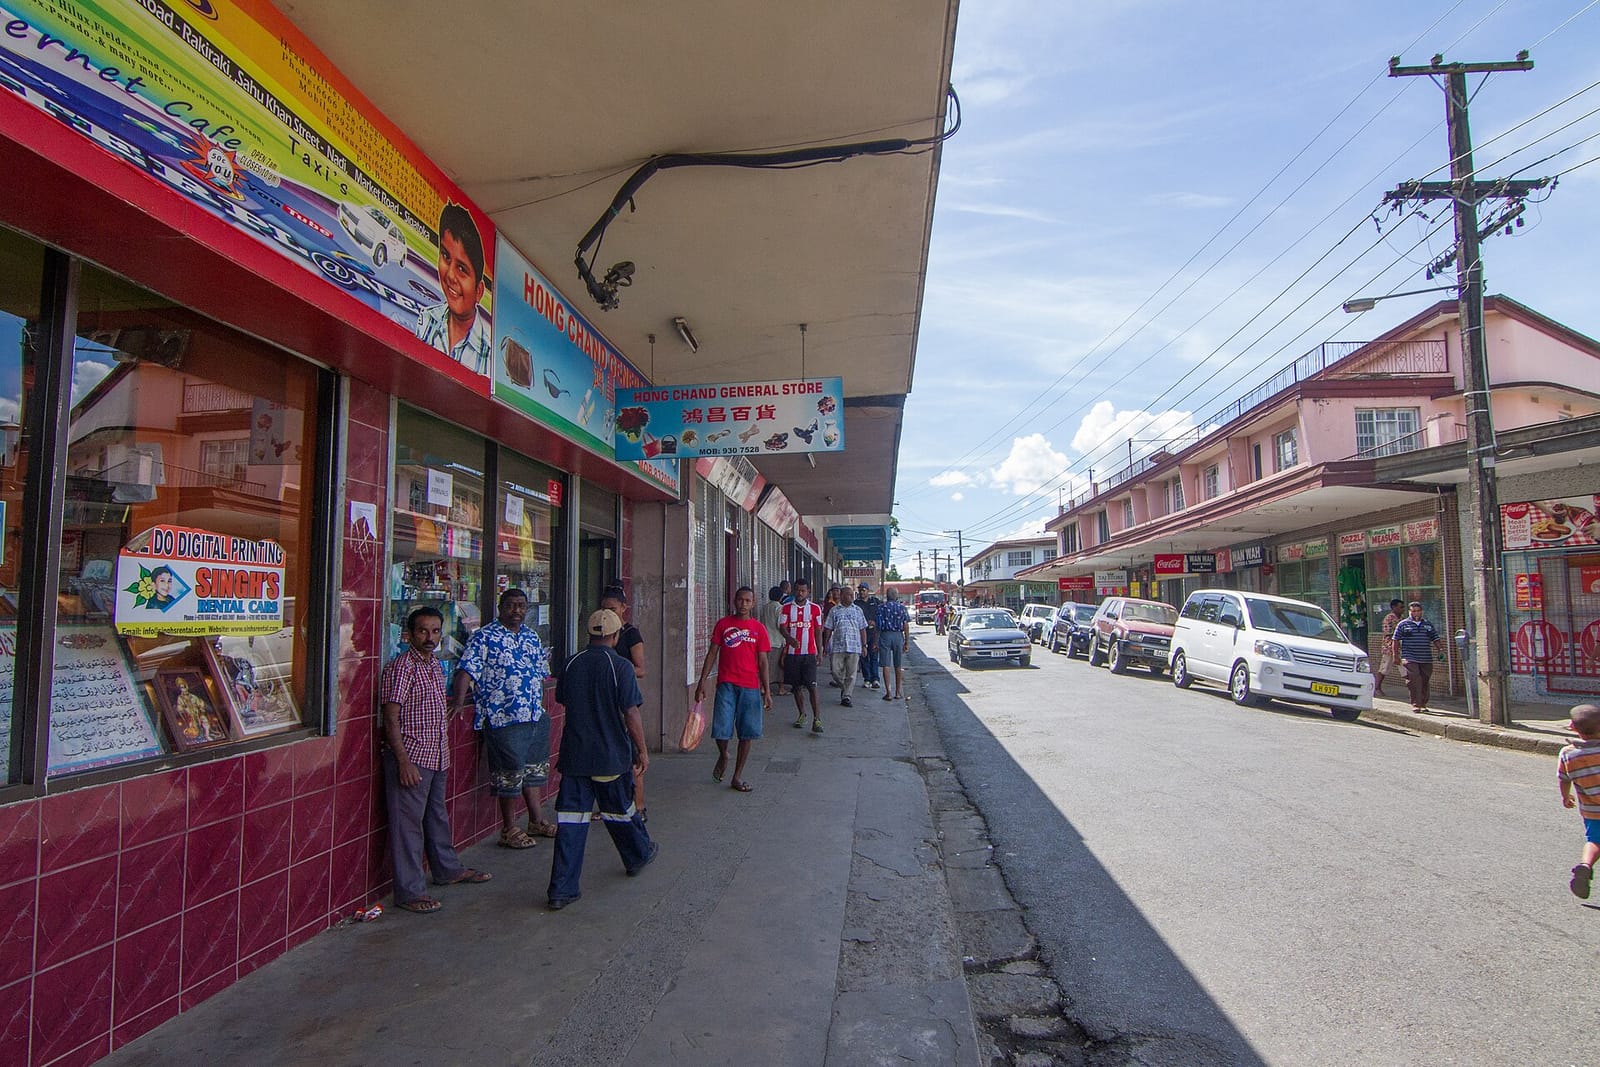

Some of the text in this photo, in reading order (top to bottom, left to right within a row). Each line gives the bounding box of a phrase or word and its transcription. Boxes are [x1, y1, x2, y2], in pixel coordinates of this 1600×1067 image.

[163, 101, 242, 150] Cafe
[266, 91, 291, 127] Khan
[355, 168, 380, 201] Market
[381, 190, 398, 215] Road
[287, 134, 349, 196] Taxi's
[204, 162, 239, 183] HOUR
[523, 271, 565, 332] HONG
[567, 310, 608, 369] CHAND
[633, 382, 824, 403] HONG CHAND GENERAL STORE
[699, 445, 760, 455] MOB: 930 7528
[153, 528, 284, 565] DO DIGITAL PRINTING
[194, 567, 280, 600] SINGH'S
[850, 568, 874, 577] FASHION
[197, 599, 278, 613] RENTAL CARS
[1324, 686, 1336, 694] 937
